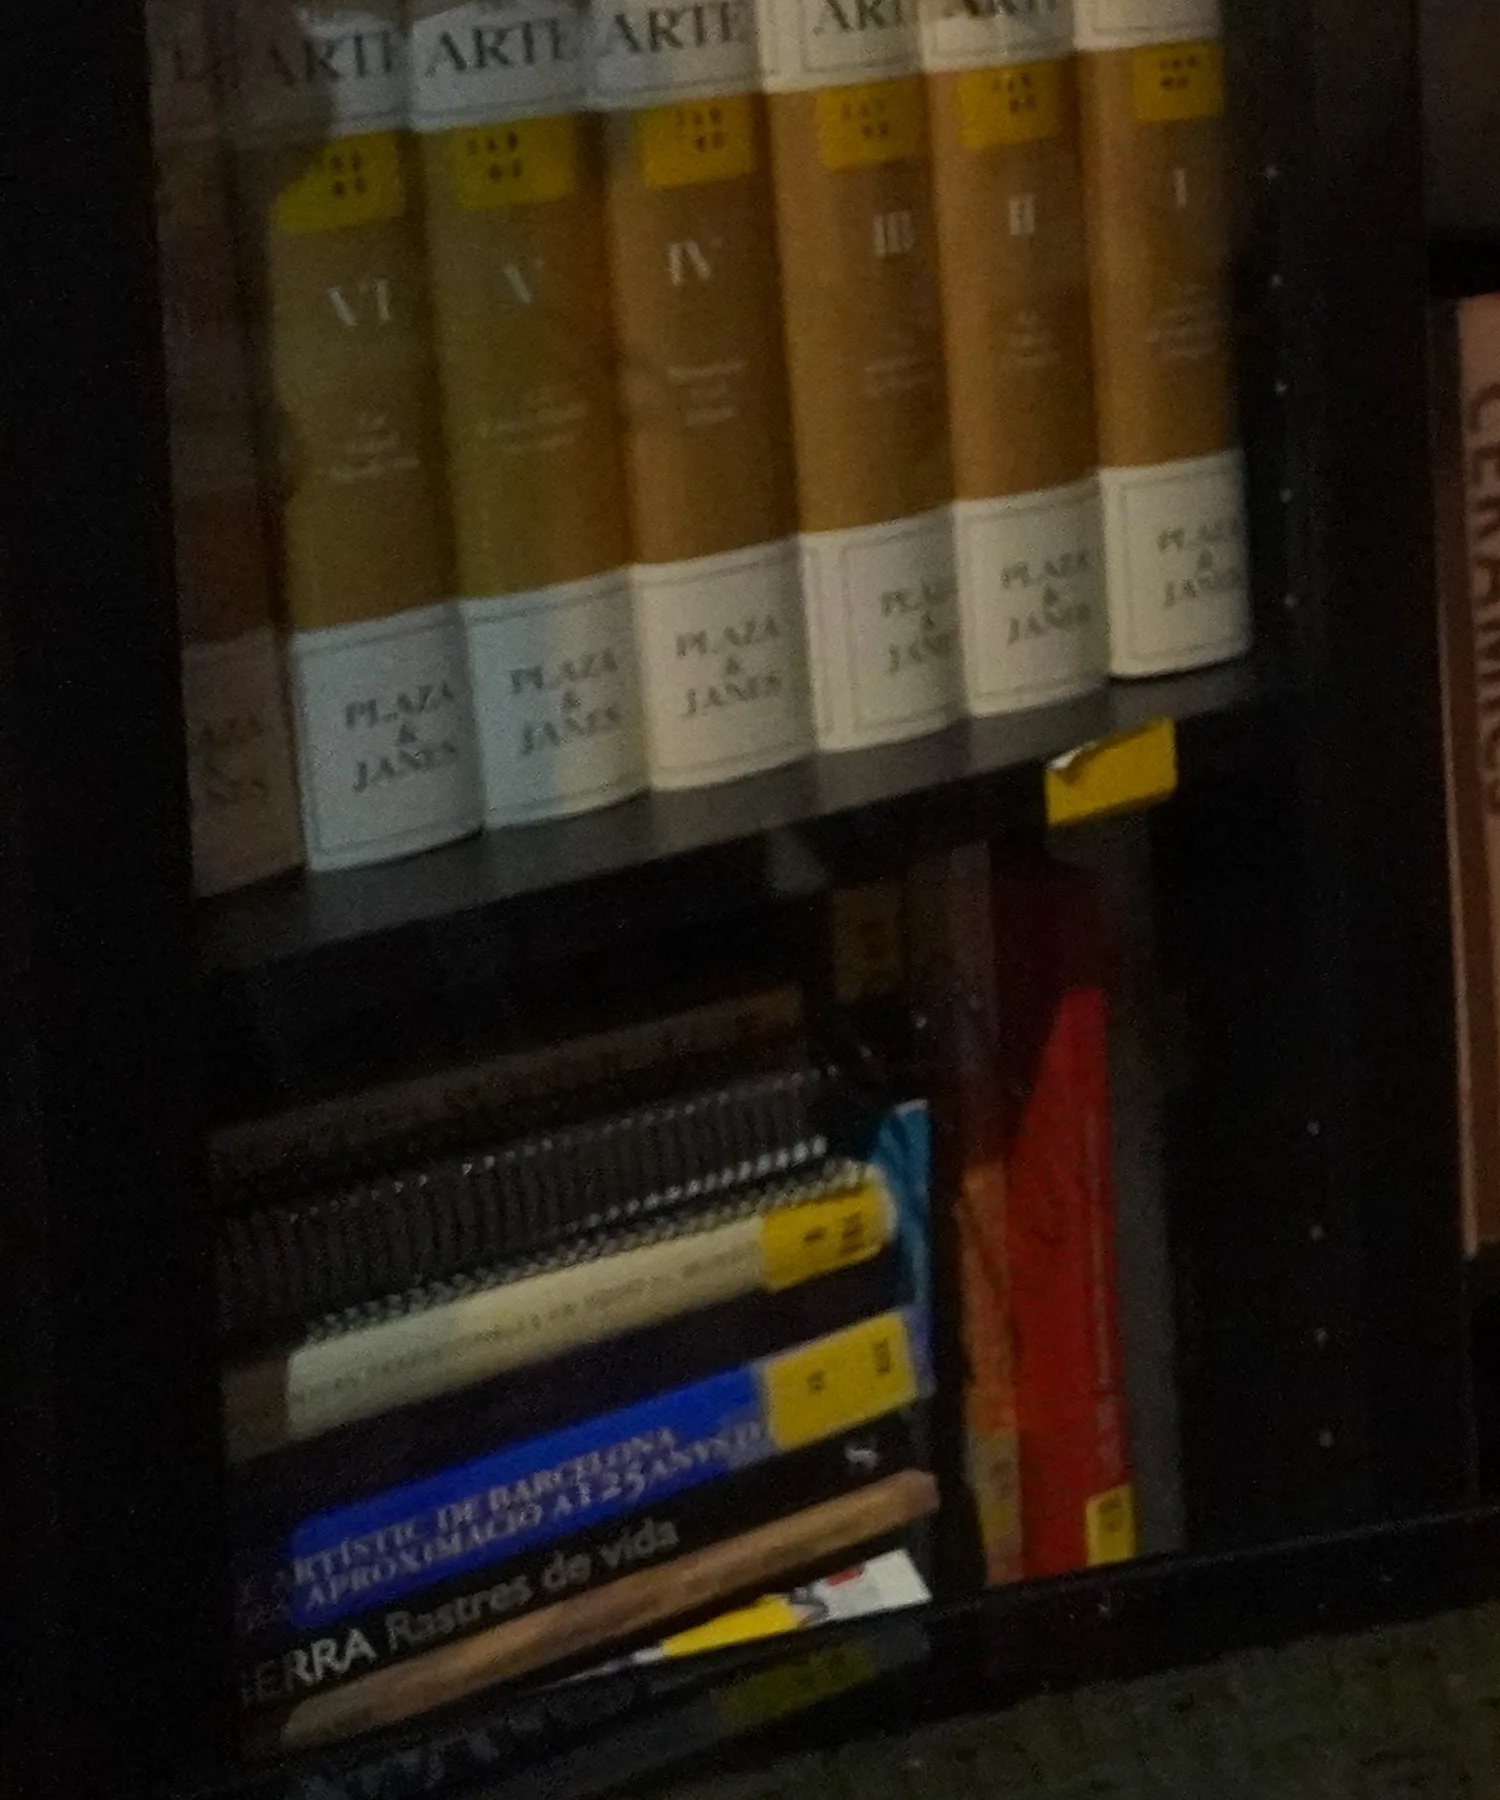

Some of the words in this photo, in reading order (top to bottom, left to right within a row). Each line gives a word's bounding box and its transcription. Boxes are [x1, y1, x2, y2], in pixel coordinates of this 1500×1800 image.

[665, 238, 724, 284] IV
[327, 281, 394, 331] VI
[490, 1428, 679, 1514] BARCELONA
[384, 1572, 534, 1653] Rastres
[540, 1541, 594, 1590] de
[600, 1515, 681, 1570] vida
